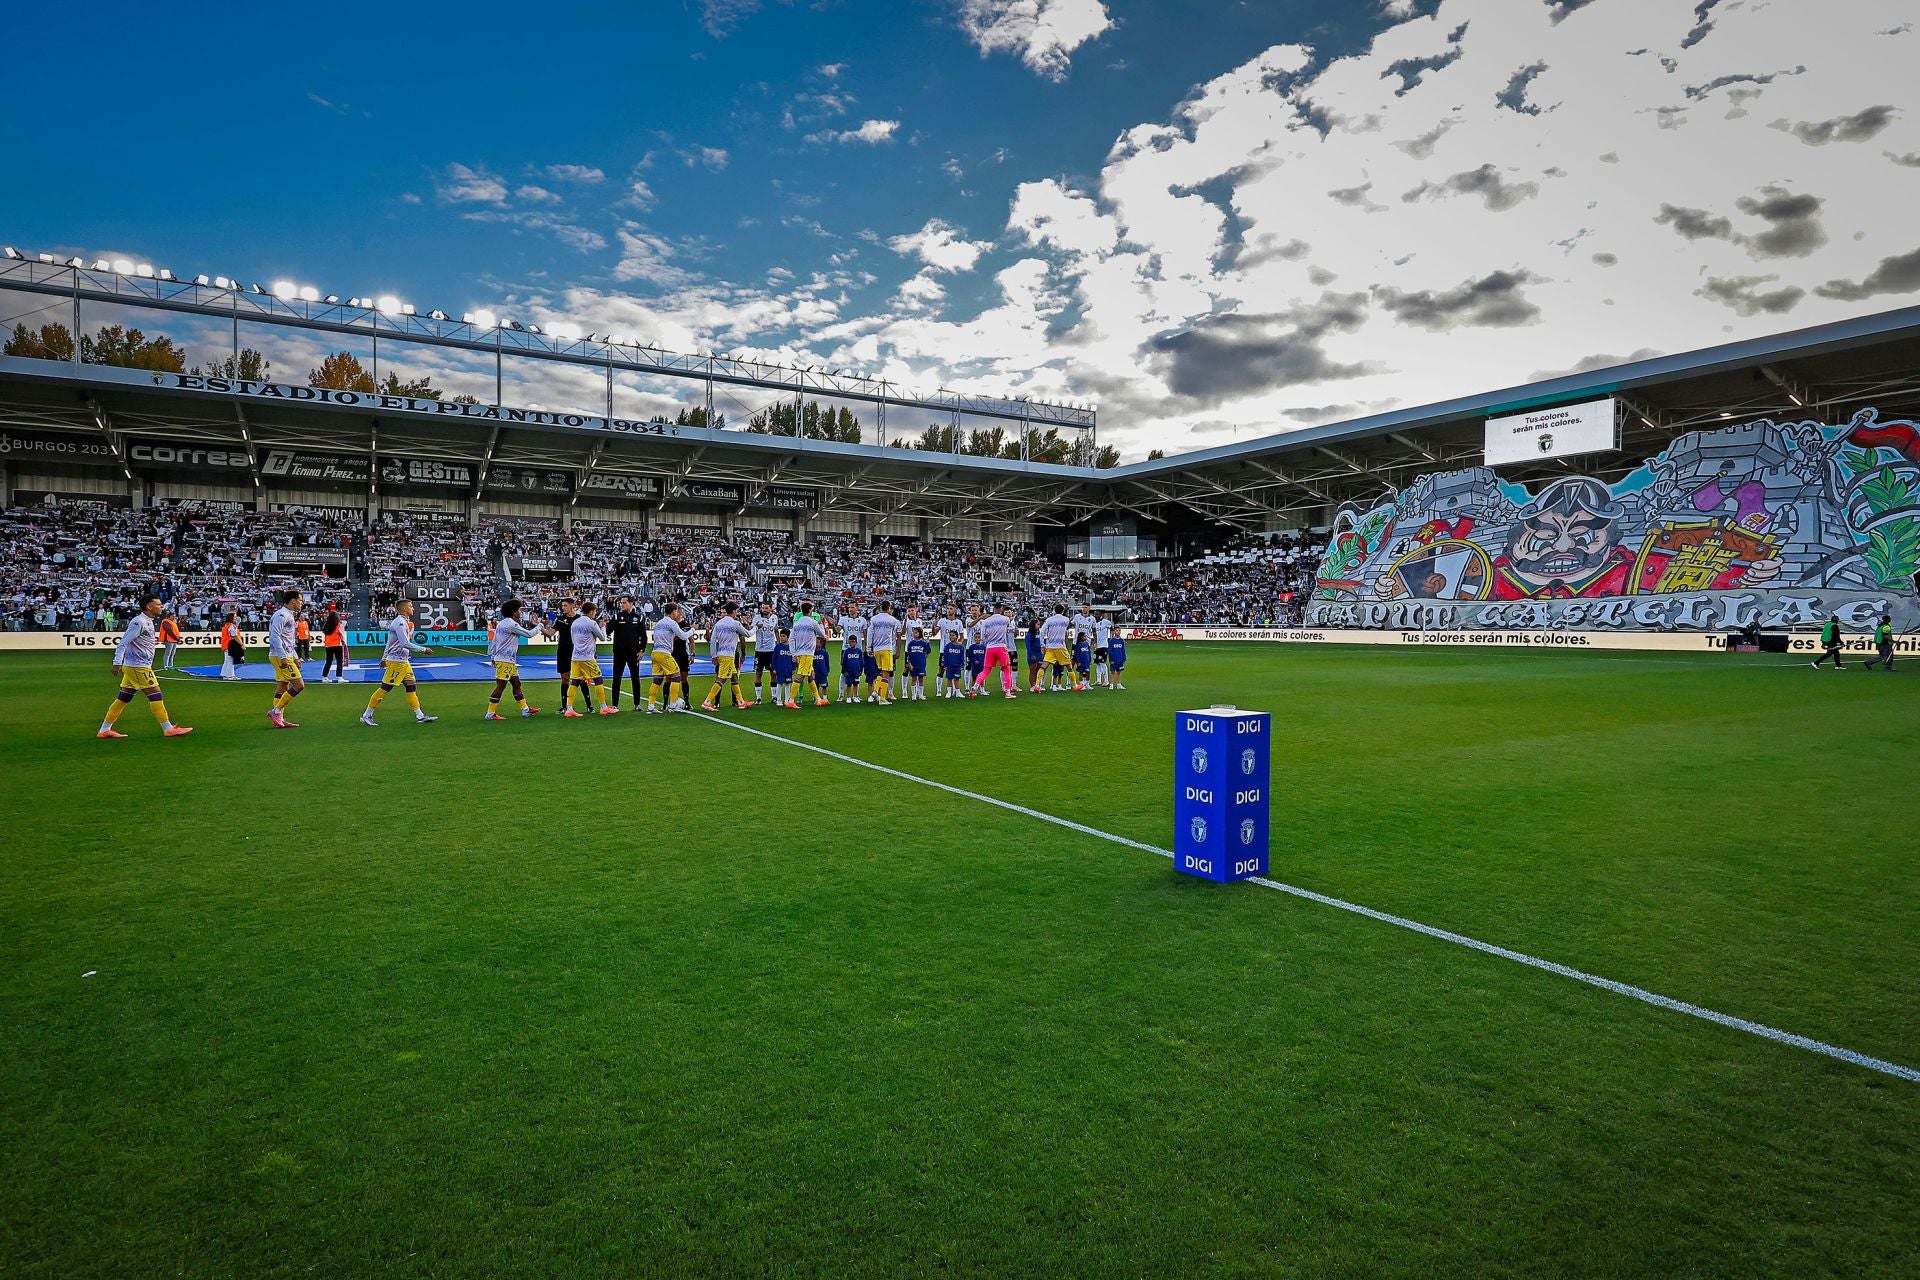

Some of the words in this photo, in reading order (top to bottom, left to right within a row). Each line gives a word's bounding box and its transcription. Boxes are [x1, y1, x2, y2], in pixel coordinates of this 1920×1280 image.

[175, 374, 360, 404] ESTADIO
[601, 418, 666, 435] 1964
[1525, 416, 1539, 424] Tus
[1539, 411, 1569, 422] colores
[1512, 423, 1533, 433] serán
[1535, 421, 1549, 430] mis
[1550, 416, 1582, 428] colores.
[13, 439, 77, 453] BURGOS
[131, 445, 250, 467] correa
[586, 473, 658, 493] BEROIL
[692, 485, 739, 499] CaixaBank
[773, 488, 815, 497] Universidad
[773, 497, 808, 508] Isabel
[694, 528, 720, 538] PEREZ
[996, 541, 1025, 551] DIGI
[965, 572, 985, 581] DIGI
[417, 587, 450, 599] DIGI
[1311, 602, 1462, 630] CAPUT
[63, 634, 96, 646] Tus
[177, 633, 222, 646] serán
[356, 633, 389, 645] LALI
[432, 634, 489, 642] HYPERMO
[543, 633, 560, 643] Tu
[1205, 630, 1218, 639] Tus
[1218, 630, 1247, 640] colores
[1248, 629, 1271, 639] serán
[1272, 630, 1288, 640] mis
[1289, 630, 1326, 641] colores.
[1401, 632, 1420, 643] Tus
[1425, 633, 1466, 643] colores
[1468, 632, 1503, 643] serán
[1506, 632, 1531, 644] mis
[1534, 632, 1590, 645] colores.
[1705, 635, 1727, 648] Tu
[142, 671, 154, 681] 14
[1187, 718, 1214, 734] DIGI
[1237, 719, 1261, 735] DIGI
[1186, 786, 1213, 804] DIGI
[1236, 788, 1260, 805] DIGI
[1185, 855, 1212, 874] DIGI
[1235, 857, 1259, 875] DIGI
